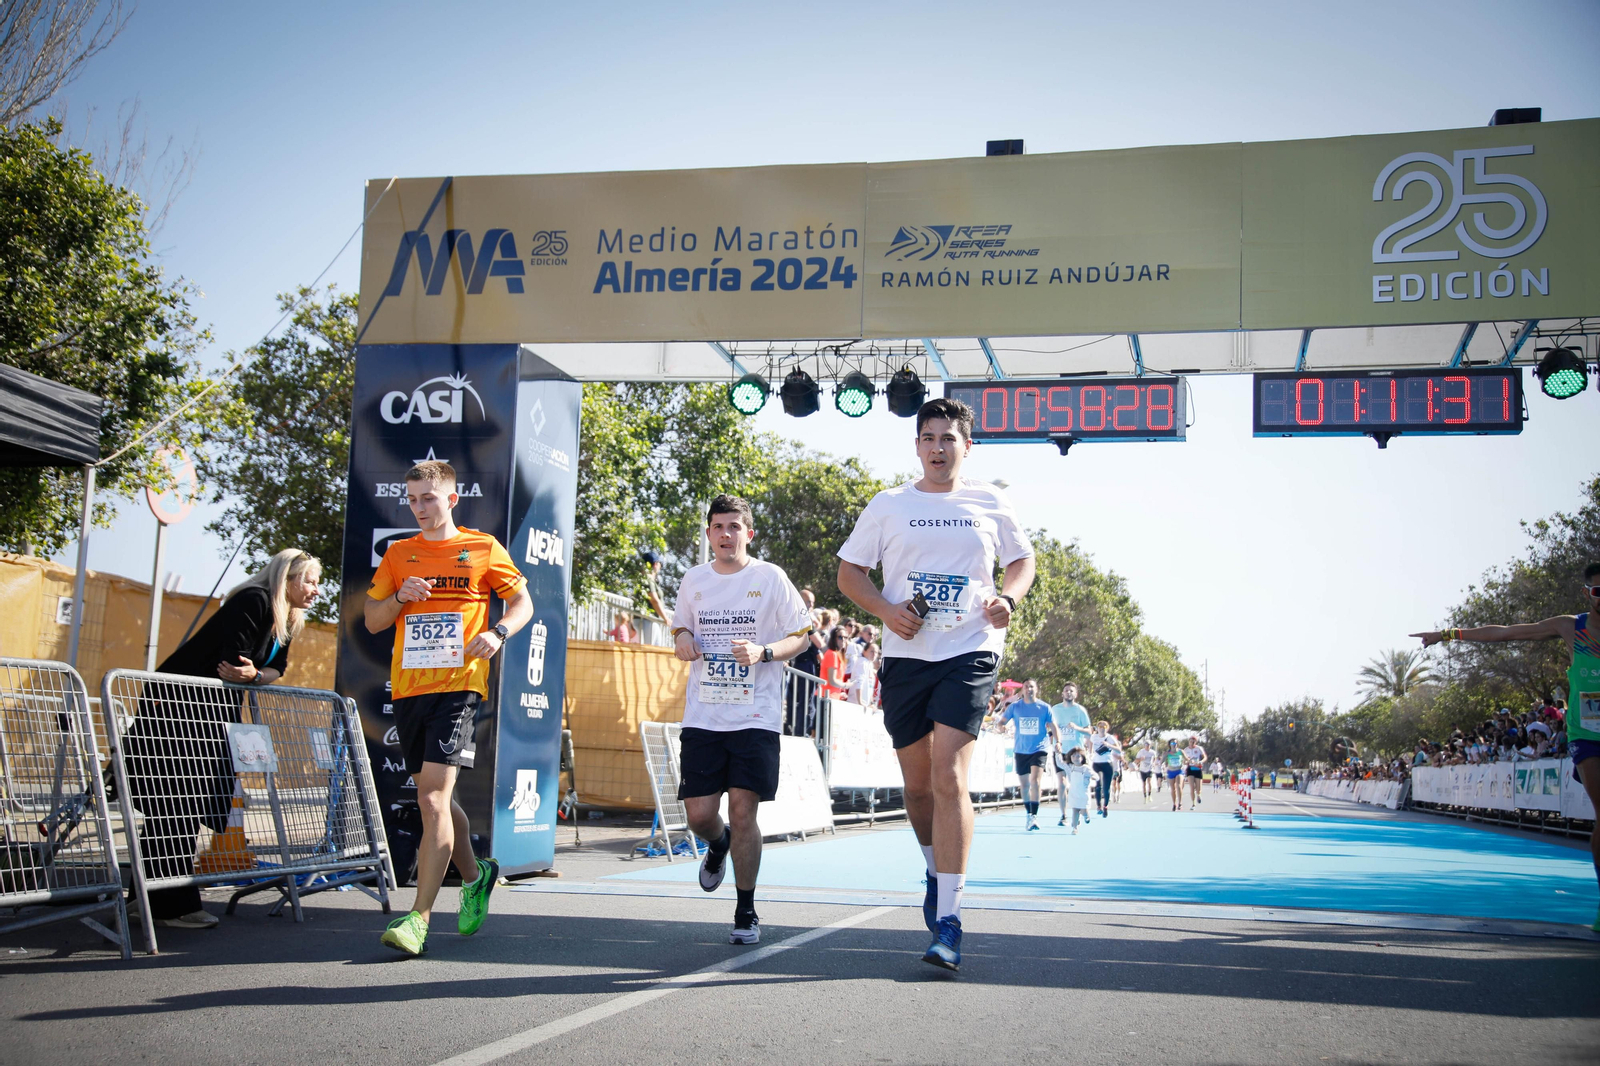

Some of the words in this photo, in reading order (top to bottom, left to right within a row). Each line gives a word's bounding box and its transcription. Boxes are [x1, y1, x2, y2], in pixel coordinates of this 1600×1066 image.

[1372, 144, 1549, 264] 25
[532, 231, 569, 256] 25
[597, 226, 697, 254] Medio
[714, 223, 858, 252] Maratón
[531, 256, 568, 266] EDICIÓN
[943, 250, 979, 260] RUTA
[983, 248, 1041, 259] RUNNING
[593, 259, 741, 294] Almería
[750, 257, 858, 291] 2024
[881, 267, 970, 288] RAMÓN
[982, 268, 1039, 286] RUIZ
[1049, 262, 1171, 284] ANDÚJAR
[1373, 262, 1550, 303] EDICIÓN
[380, 390, 463, 424] CASI
[909, 519, 981, 528] COSENTINO
[912, 582, 963, 602] 5287
[411, 622, 457, 641] 5622
[698, 616, 730, 625] Almería
[731, 616, 756, 624] 2024
[707, 662, 750, 678] 5419
